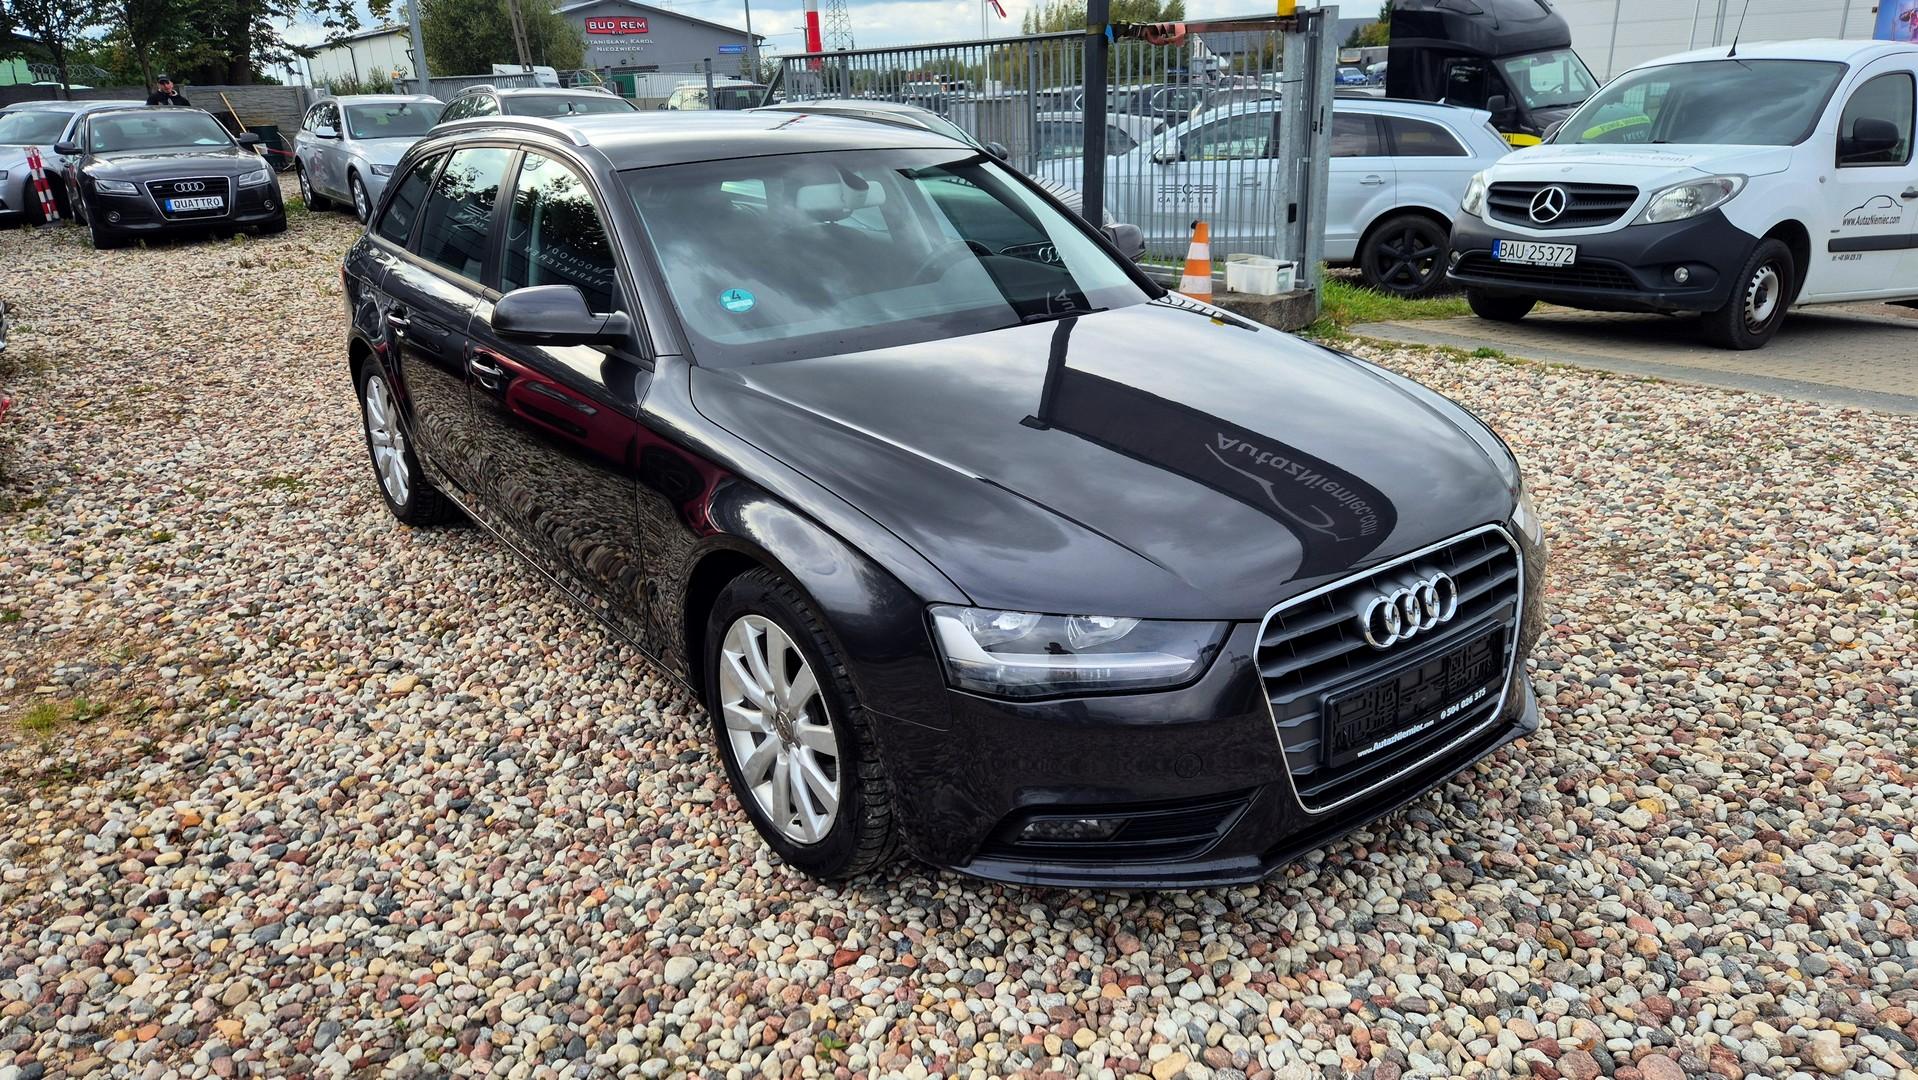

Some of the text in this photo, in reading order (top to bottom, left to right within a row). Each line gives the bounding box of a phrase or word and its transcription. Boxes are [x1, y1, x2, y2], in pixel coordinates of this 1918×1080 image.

[589, 21, 646, 29] BUD REM
[173, 197, 220, 209] QUATTRO
[1499, 242, 1574, 264] BAU 25372
